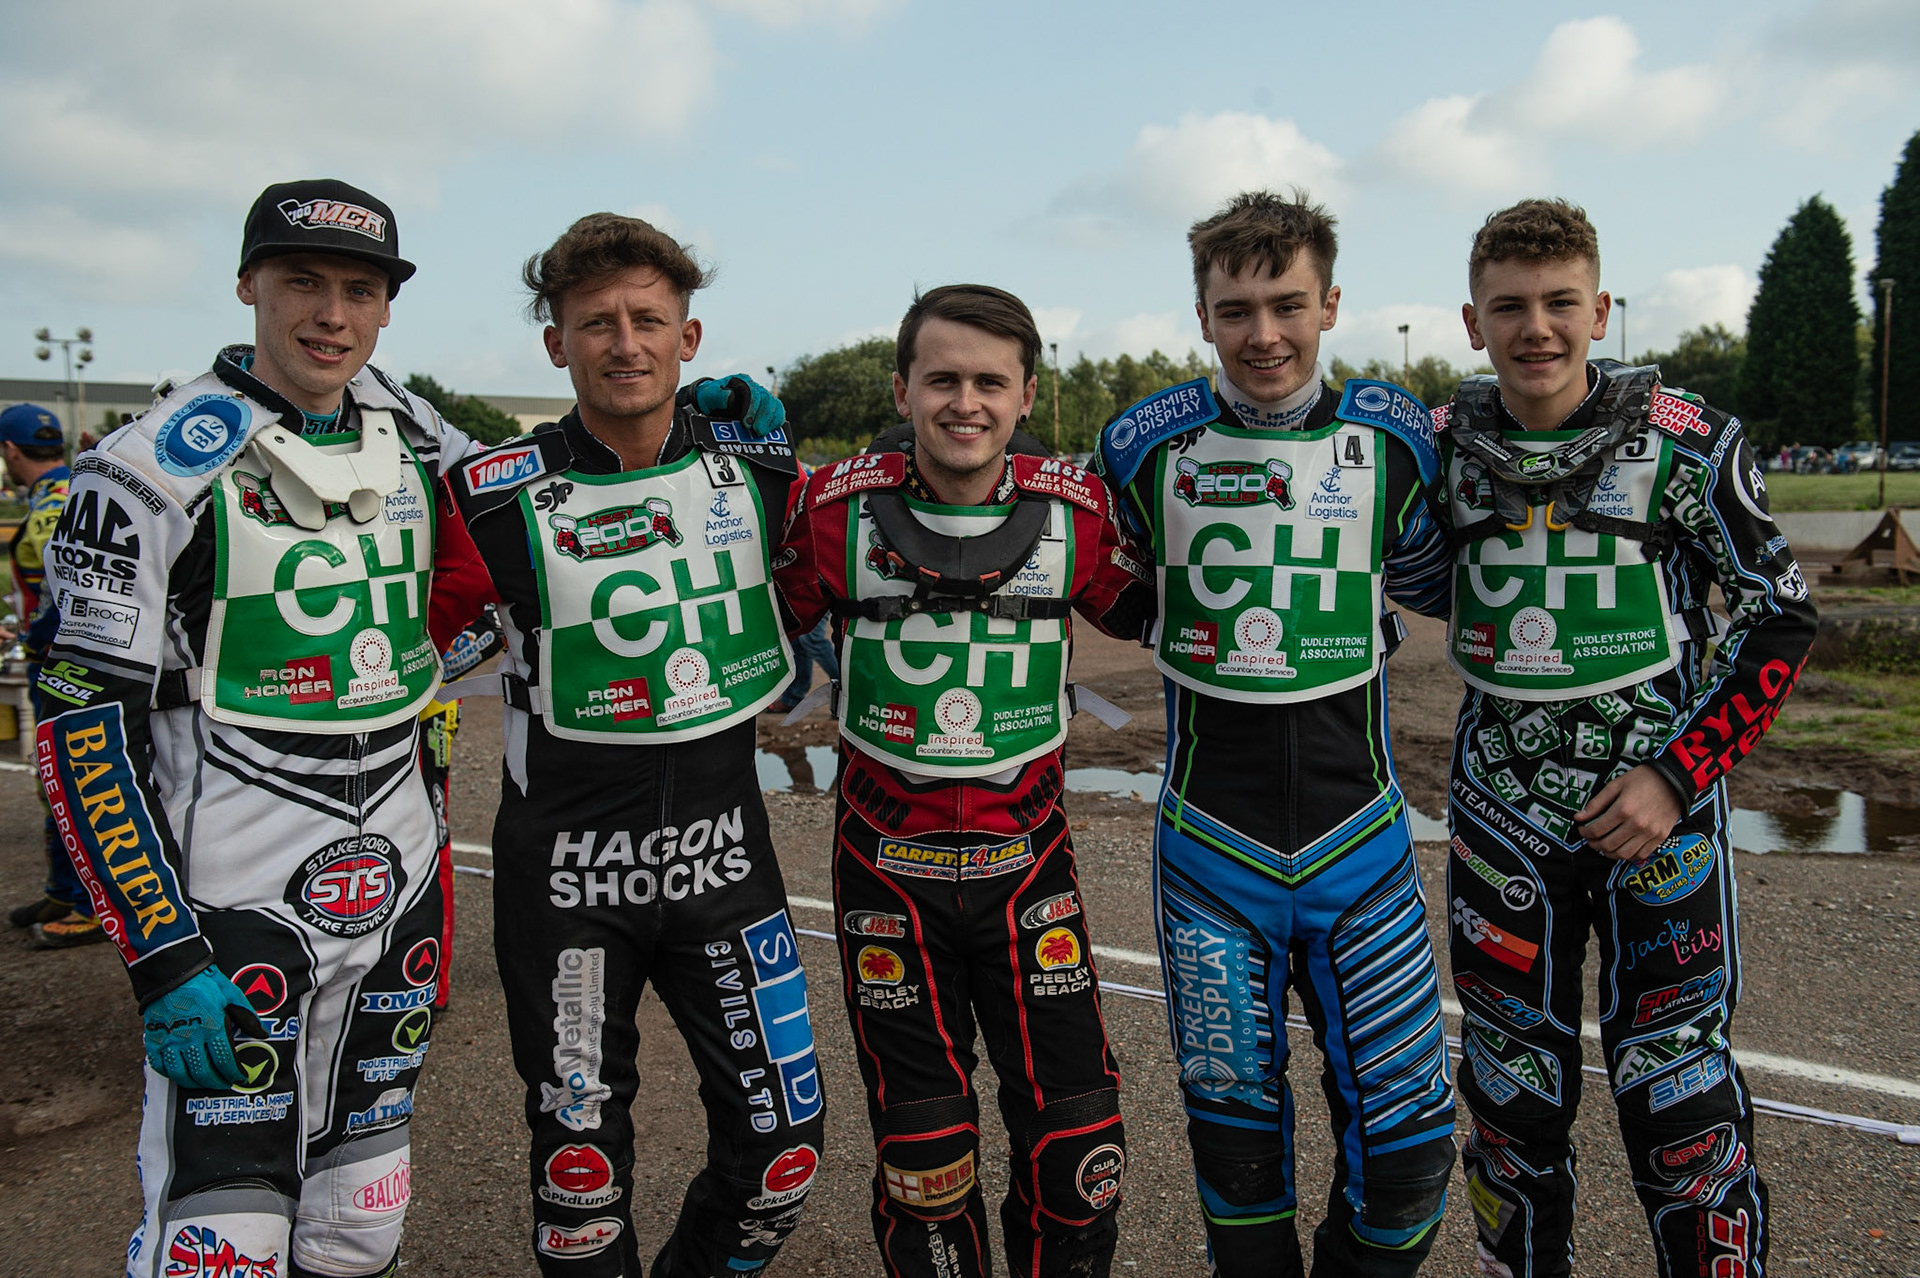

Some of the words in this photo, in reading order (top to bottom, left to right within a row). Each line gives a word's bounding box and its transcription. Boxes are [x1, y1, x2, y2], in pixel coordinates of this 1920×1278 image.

[1135, 387, 1200, 422] PREMIER
[1655, 395, 1700, 417] TOWN
[1138, 398, 1201, 435] DISPLAY
[1147, 431, 1162, 440] for
[1166, 413, 1206, 431] success
[1352, 411, 1388, 423] stands
[1392, 422, 1406, 432] for
[188, 419, 224, 450] BTS
[1625, 427, 1648, 457] 5
[205, 428, 246, 471] SERVICES
[719, 444, 764, 454] CIVILS
[769, 445, 792, 457] LTD
[1344, 436, 1364, 465] 4
[476, 453, 533, 487] 100%
[712, 453, 736, 484] 3
[1208, 465, 1254, 474] HSST
[824, 475, 849, 491] SELF
[851, 469, 885, 480] DRIVE
[849, 476, 894, 490] TRUCKS
[1033, 472, 1060, 483] SELF
[1062, 478, 1091, 496] DRIVE
[1197, 474, 1266, 493] 200
[385, 494, 417, 507] Anchor
[1023, 479, 1052, 491] VANS
[1062, 487, 1099, 510] TRUCKS
[1202, 492, 1258, 502] CLUB
[1311, 493, 1352, 505] Anchor
[385, 508, 424, 523] Logistics
[588, 509, 633, 527] HSST
[1308, 505, 1358, 519] Logistics
[52, 490, 140, 560] MAC
[578, 515, 650, 546] 200
[706, 516, 743, 531] Anchor
[588, 535, 647, 556] CLUB
[705, 529, 752, 545] Logistics
[51, 545, 137, 581] TOOLS
[1187, 522, 1340, 612] CH
[1469, 533, 1616, 609] CH
[274, 528, 419, 636] CH
[1011, 570, 1050, 581] Anchor
[1008, 582, 1053, 596] Logistics
[591, 550, 744, 657] CH
[479, 633, 493, 648] LTD
[1180, 628, 1209, 641] RON
[1300, 637, 1334, 647] DUDLEY
[1335, 636, 1367, 646] STROKE
[1461, 628, 1487, 642] RON
[1573, 633, 1616, 645] DUDLEY
[1616, 628, 1656, 641] STROKE
[883, 610, 1031, 687] CH
[1169, 641, 1216, 657] HOMER
[1230, 652, 1284, 666] inspired
[1300, 646, 1365, 660] ASSOCIATION
[1507, 652, 1560, 665] inspired
[1573, 640, 1656, 658] ASSOCIATION
[722, 657, 753, 675] DUDLEY
[753, 646, 780, 664] STROKE
[1218, 664, 1263, 676] Accountancy
[1265, 667, 1295, 676] Services
[1496, 664, 1540, 673] Accountancy
[1541, 665, 1572, 673] Services
[260, 667, 315, 682] RON
[351, 674, 398, 694] inspired
[724, 660, 781, 688] ASSOCIATION
[244, 680, 331, 699] HOMER
[340, 692, 384, 706] Accountancy
[385, 687, 407, 700] Services
[588, 686, 634, 702] RON
[667, 687, 718, 710] inspired
[575, 698, 649, 719] HOMER
[658, 705, 703, 724] Accountancy
[704, 699, 729, 713] Services
[868, 704, 907, 721] RON
[993, 709, 1025, 721] DUDLEY
[1025, 704, 1054, 716] STROKE
[859, 716, 915, 738] HOMER
[993, 714, 1052, 734] ASSOCIATION
[917, 747, 963, 756] Accountancy
[965, 747, 993, 756] Services
[930, 734, 983, 748] inspired
[1452, 778, 1550, 857] #TEAMWARD
[65, 721, 178, 940] BARRIER
[550, 806, 745, 867] HAGON
[38, 739, 59, 793] FIRE
[53, 802, 127, 949] PROTECTION
[884, 844, 969, 867] CARPETS
[970, 847, 989, 869] 4
[989, 841, 1026, 864] LESS
[1682, 840, 1709, 865] evo
[305, 836, 391, 875] STAKEFORD
[1451, 837, 1508, 888] PRO-GREEN
[310, 864, 389, 904] STS
[550, 847, 752, 908] SHOCKS
[1655, 877, 1688, 900] Racing
[303, 908, 342, 933] TYRE
[1672, 923, 1720, 965] Lily
[589, 953, 600, 994] Limited
[1030, 967, 1089, 984] PEBLEY
[1235, 932, 1248, 1005] success
[857, 984, 919, 999] PEBLEY
[1033, 978, 1091, 996] BEACH
[1176, 927, 1206, 1050] PREMIER
[1198, 929, 1234, 1053] DISPLAY
[860, 995, 919, 1010] BEACH
[1471, 986, 1516, 1018] PLATINUM
[1652, 990, 1704, 1016] PLATINUM
[588, 995, 600, 1034] Supply
[705, 940, 756, 1050] CIVILS
[740, 1067, 777, 1133] LTD
[1240, 1017, 1252, 1045] for
[188, 1098, 251, 1112] INDUSTRIAL
[255, 1099, 265, 1107] &
[196, 1111, 220, 1125] LIFT
[221, 1108, 270, 1122] SERVICES
[272, 1107, 286, 1119] LTD
[1662, 1132, 1717, 1166] GPM
[1092, 1158, 1115, 1173] CLUB
[1111, 1162, 1121, 1174] UK
[922, 1161, 972, 1194] NEB
[541, 1189, 619, 1206] @PkdLunch
